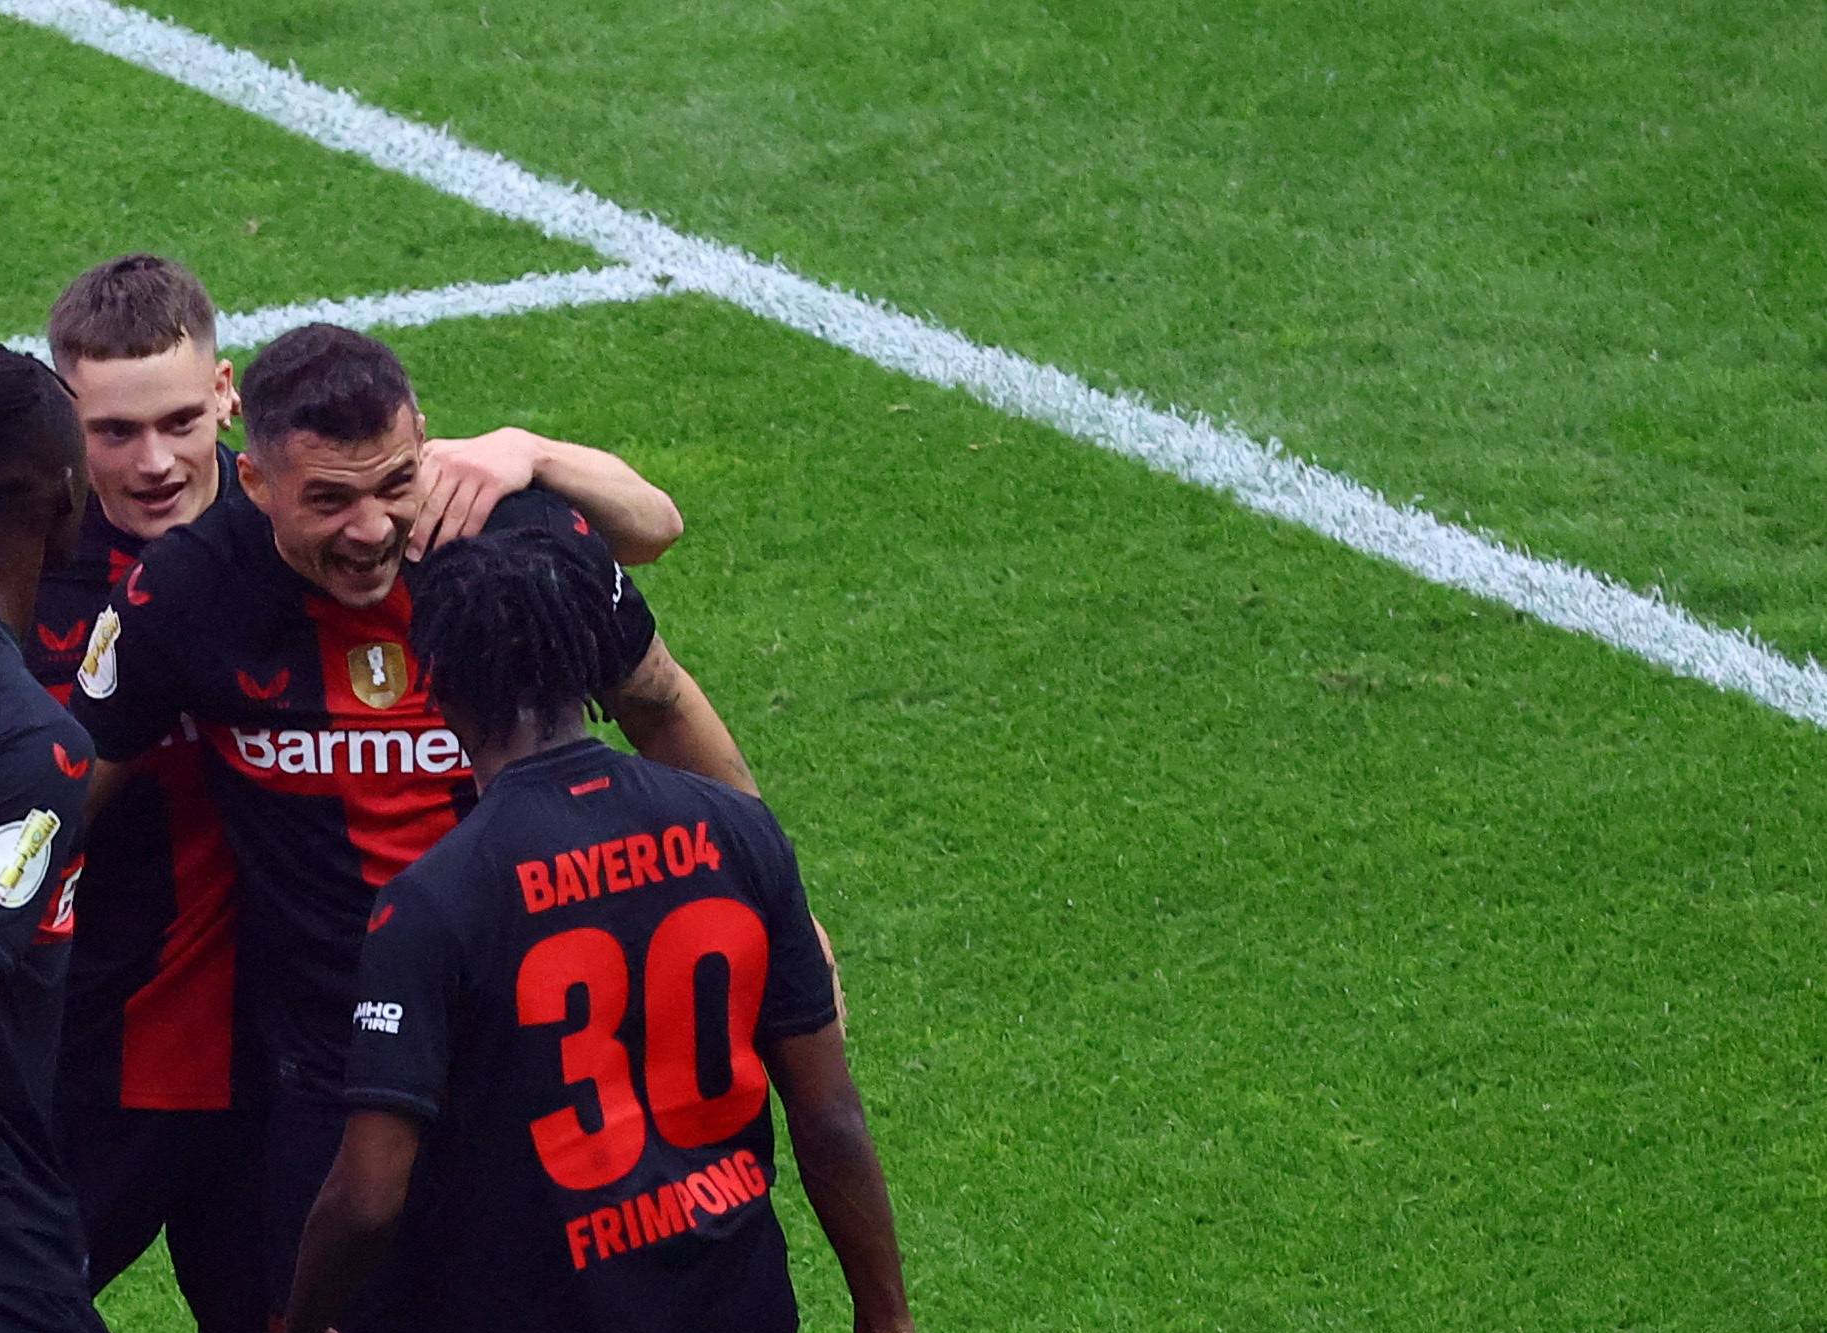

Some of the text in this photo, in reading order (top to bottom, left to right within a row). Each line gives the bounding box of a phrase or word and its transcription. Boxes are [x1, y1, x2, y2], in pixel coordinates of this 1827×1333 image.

[230, 727, 472, 774] Barme
[516, 821, 722, 914] BAYER 04
[360, 1018, 400, 1034] TIRE
[517, 897, 769, 1191] 30
[565, 1149, 769, 1271] FRIMPONG
